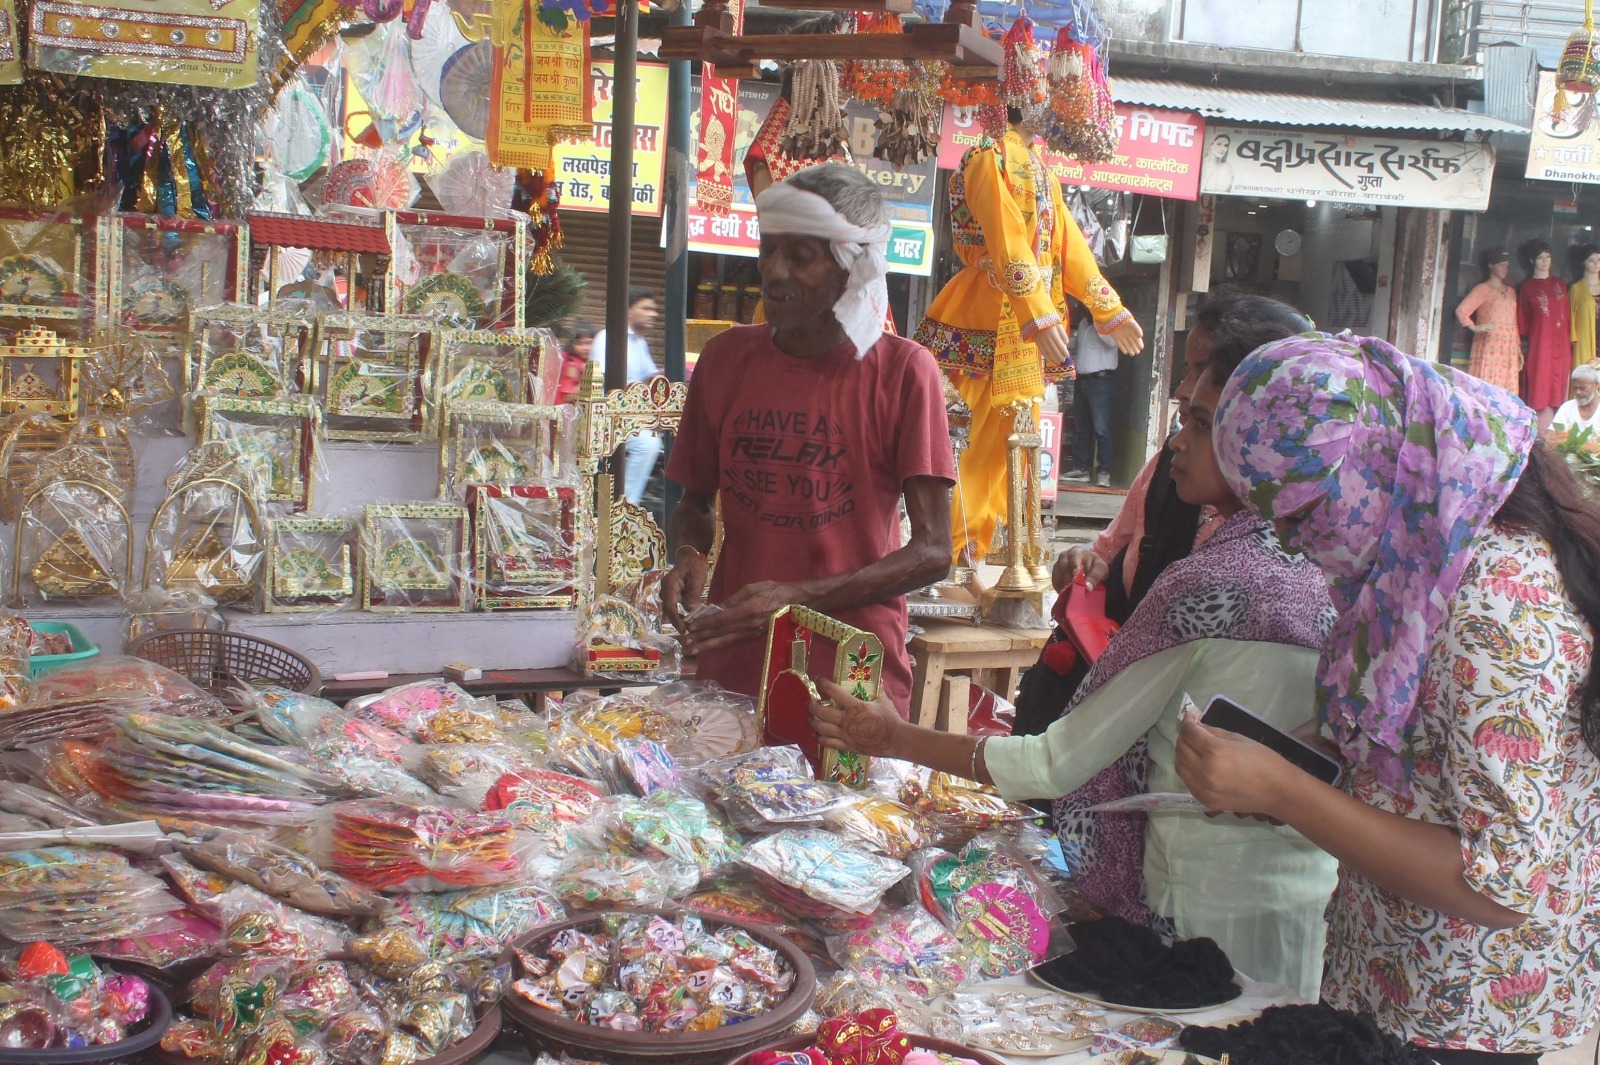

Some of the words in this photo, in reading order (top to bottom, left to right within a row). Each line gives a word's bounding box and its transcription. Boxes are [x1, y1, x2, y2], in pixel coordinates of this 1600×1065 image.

[536, 56, 550, 67] जय
[552, 52, 562, 68] श्री
[565, 54, 580, 70] राधे
[534, 73, 549, 85] जय
[550, 70, 560, 86] श्री
[563, 75, 578, 90] कृष्ण
[1130, 110, 1198, 148] गिफ्ट
[1357, 175, 1384, 191] गुप्ता
[894, 237, 923, 259] मटर
[747, 408, 808, 435] HAVE
[812, 415, 829, 438] A
[730, 435, 848, 470] RELAX
[744, 468, 778, 494] SEE
[787, 473, 830, 502] YOU
